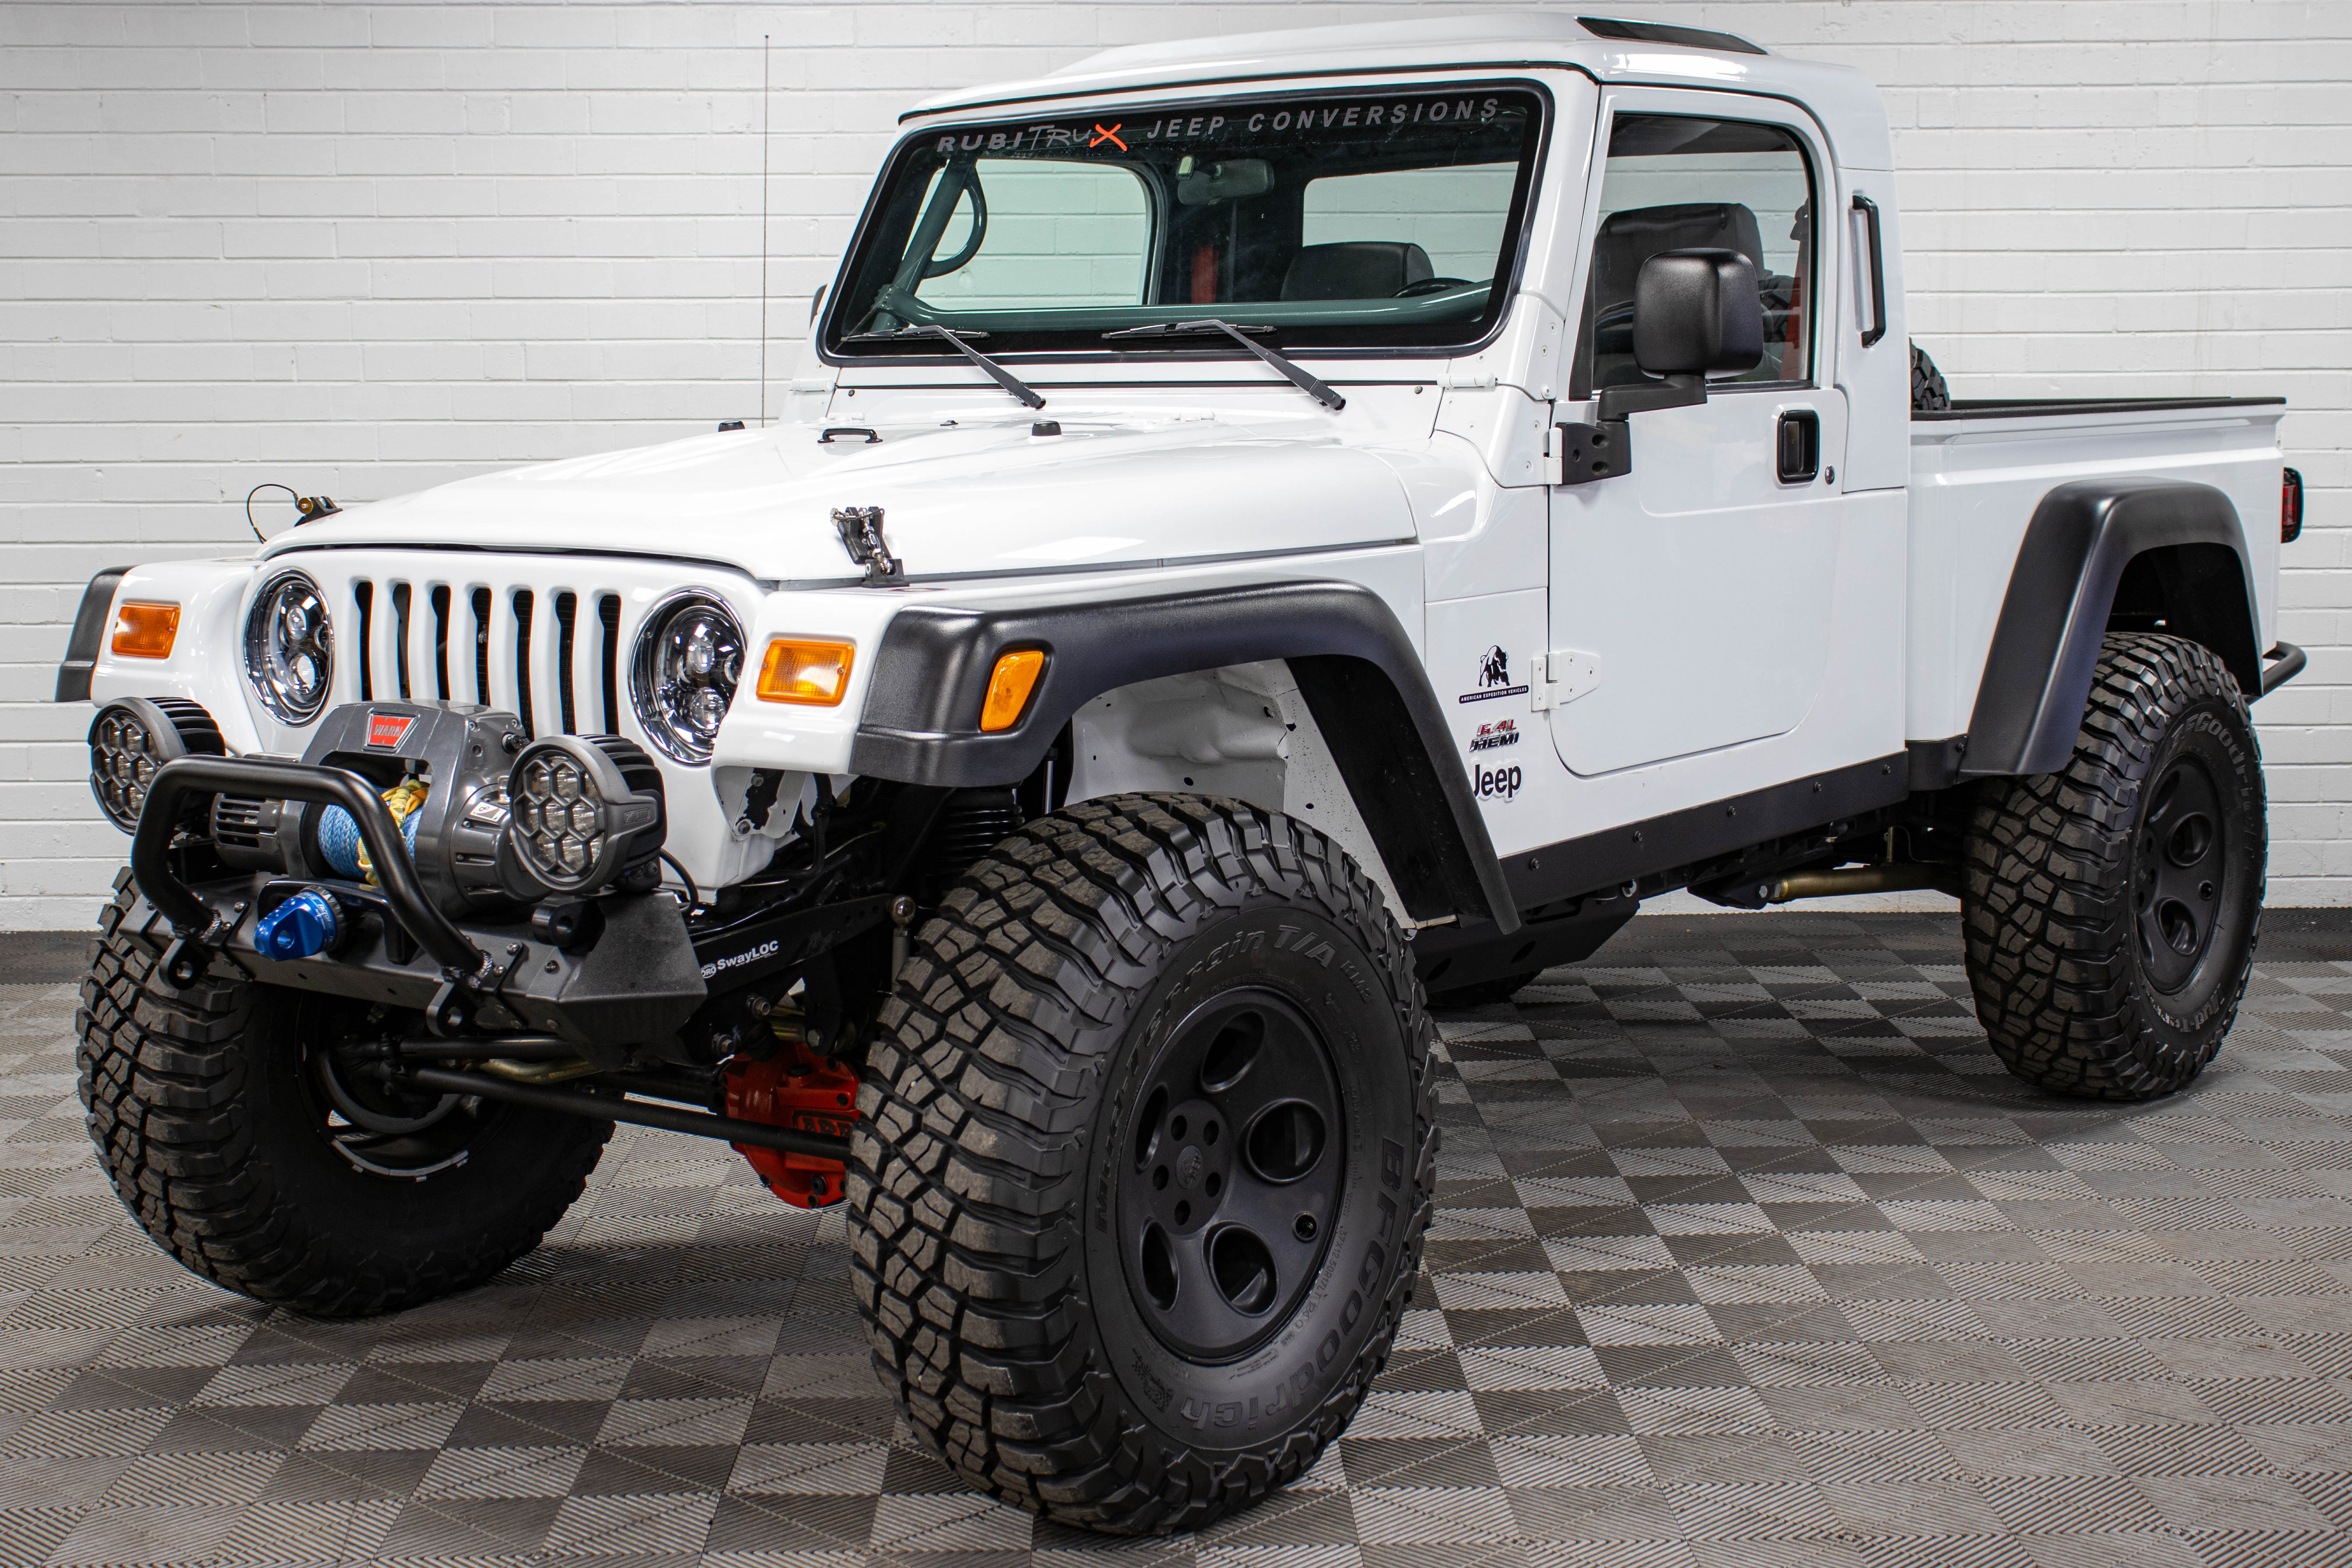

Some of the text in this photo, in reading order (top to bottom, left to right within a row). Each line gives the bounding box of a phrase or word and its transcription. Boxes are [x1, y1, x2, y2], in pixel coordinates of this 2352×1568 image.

[1147, 116, 1225, 139] JEEP
[1248, 98, 1498, 132] CONVERSIONS
[1461, 693, 1482, 702] AMERICAN
[373, 723, 403, 737] WARN
[1469, 732, 1519, 752] HEMI
[1477, 719, 1517, 737] 6.4L
[1473, 764, 1522, 798] Jeep
[717, 940, 779, 970] SwayLOC
[1271, 925, 1336, 968] T/A
[1181, 1137, 1404, 1431] BFGoodrich
